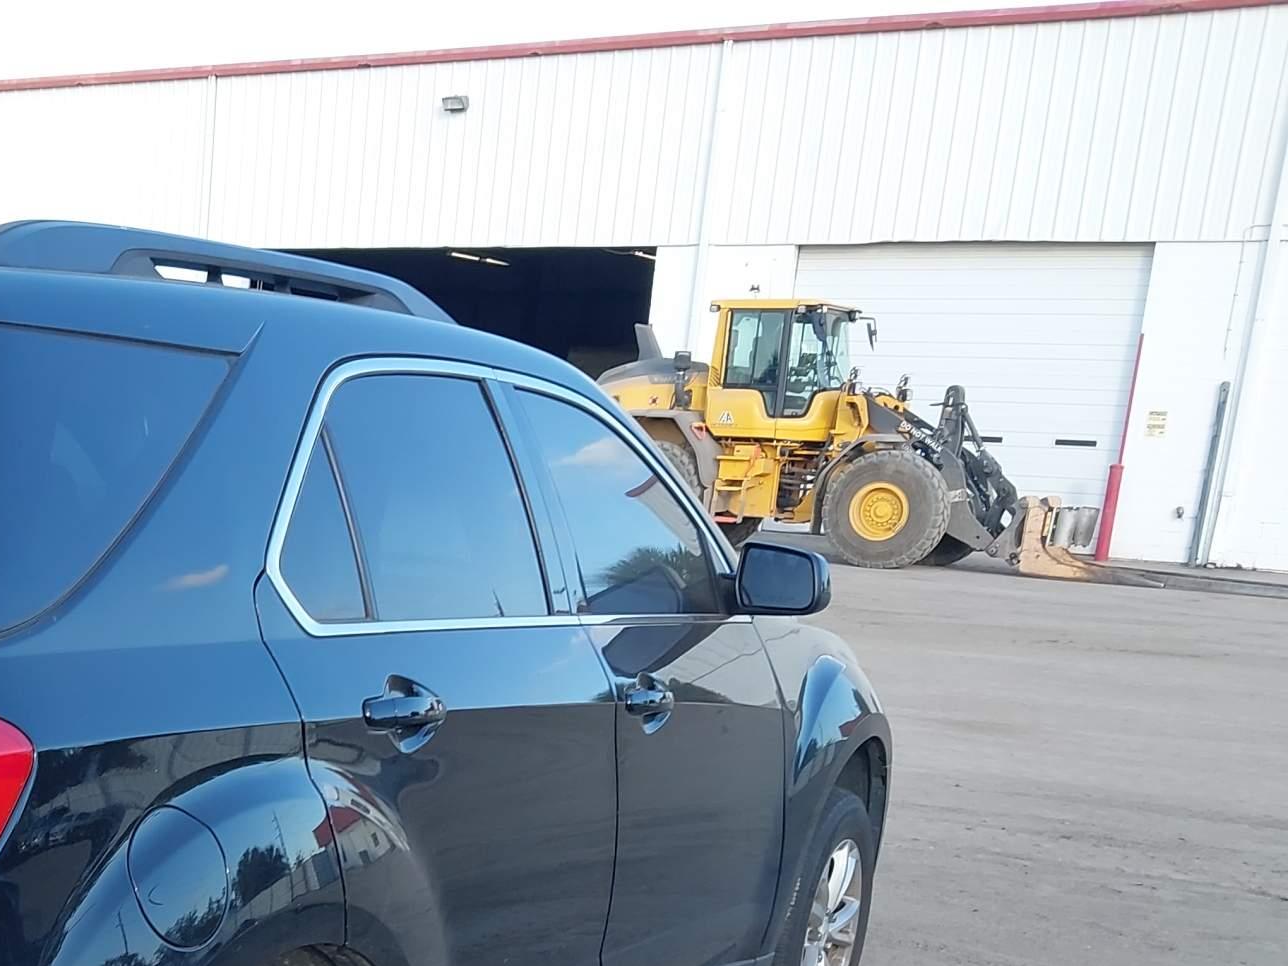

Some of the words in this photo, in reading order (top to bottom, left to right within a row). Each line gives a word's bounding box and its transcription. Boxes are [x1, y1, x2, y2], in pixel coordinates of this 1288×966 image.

[899, 420, 912, 431] DO
[910, 428, 926, 440] NOT
[924, 437, 944, 453] WALK
